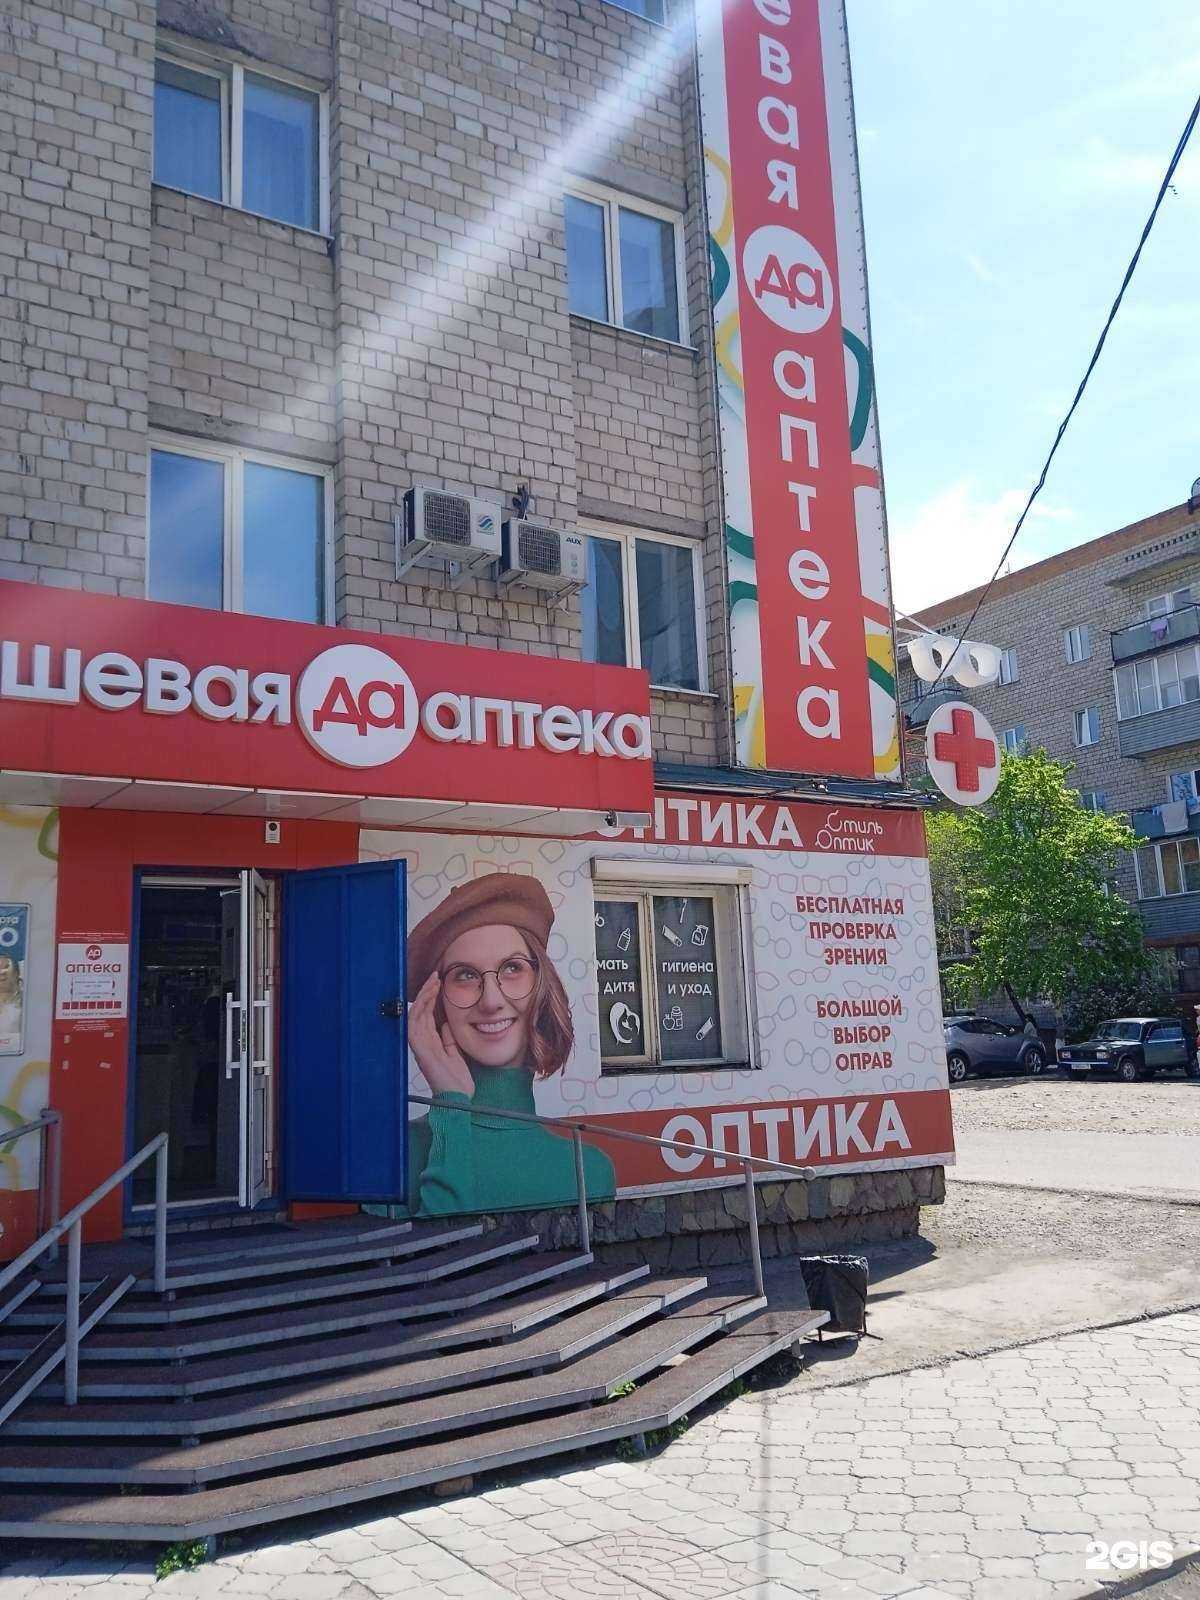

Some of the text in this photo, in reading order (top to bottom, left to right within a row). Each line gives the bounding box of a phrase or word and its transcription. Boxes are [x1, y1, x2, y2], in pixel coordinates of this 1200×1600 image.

[566, 536, 582, 545] AUX
[773, 350, 841, 740] аптека
[1, 640, 291, 726] шевая
[421, 691, 652, 760] аптека
[596, 797, 803, 848] ПТИКА
[825, 810, 883, 835] Стиль
[815, 829, 875, 852] Оптик
[796, 895, 905, 916] БЕСПЛАТНАЯ
[809, 921, 897, 940] ПРОВЕРКА
[597, 959, 628, 970] мать
[824, 948, 888, 966] ЗРЕНИЯ
[65, 963, 121, 973] аптека
[662, 961, 714, 973] гигиена
[603, 981, 635, 995] дитя
[667, 984, 712, 997] и уход
[816, 995, 902, 1019] БОЛЬШОЙ
[833, 1027, 891, 1045] ВЫБОР
[835, 1053, 893, 1072] ОПРАВ
[660, 1100, 912, 1173] ОПТИКА
